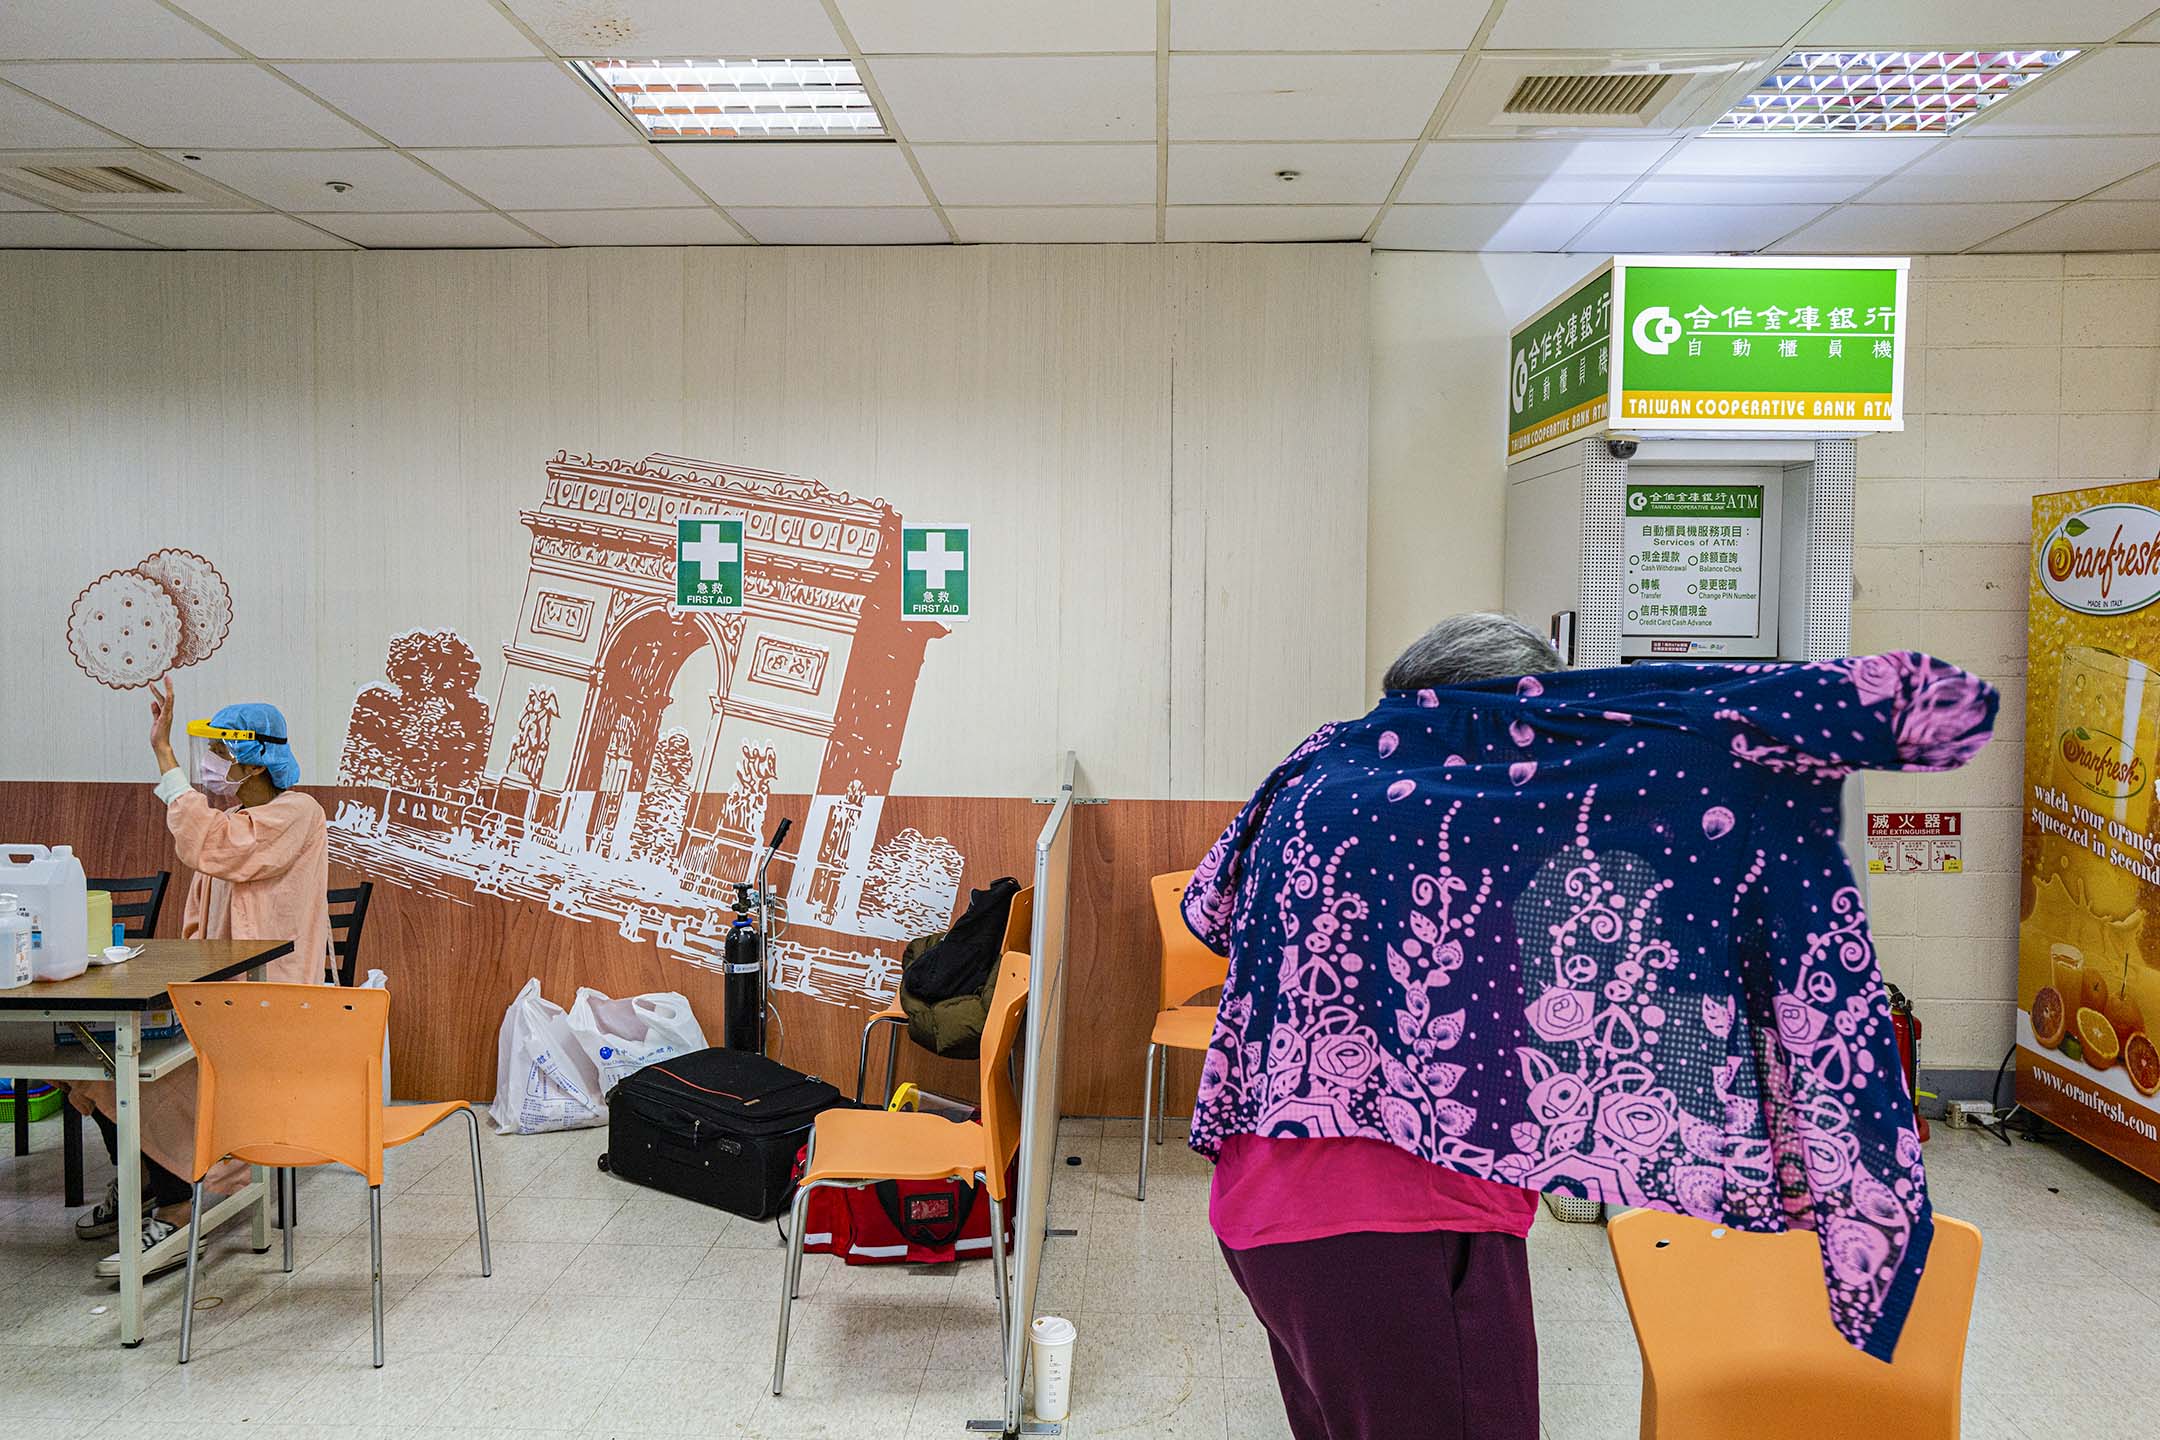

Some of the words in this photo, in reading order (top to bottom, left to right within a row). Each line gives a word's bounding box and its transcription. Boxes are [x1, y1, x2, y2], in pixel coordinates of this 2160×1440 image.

[1683, 304, 1895, 331] 合作金庫銀行
[1528, 291, 1611, 372] 合作金庫銀行
[1687, 337, 1893, 359] 自動櫃員機
[1629, 399, 1691, 415] TAIWAN
[1695, 399, 1806, 416] COOPERATIVE
[1813, 401, 1856, 417] BANK
[1863, 401, 1893, 417] ATM
[1511, 434, 1532, 452] TAIWAN
[1531, 417, 1570, 445] COOPERATIVE
[1572, 409, 1590, 427] BANK
[1592, 402, 1608, 422] ATM
[1726, 494, 1758, 509] ATM
[1653, 538, 1695, 546] Services
[1699, 538, 1709, 546] of
[1713, 538, 1738, 546] ATM:
[1641, 551, 1680, 563] 現金提款
[1699, 551, 1738, 564] 餘額查詢
[1656, 564, 1688, 572] Withdrawal
[1699, 565, 1723, 573] Balance
[1724, 565, 1742, 573] Check
[696, 582, 723, 595] 急救
[686, 595, 715, 605] FIRST
[716, 596, 733, 605] AID
[922, 591, 950, 604] 急救
[1698, 592, 1721, 601] Change
[1734, 592, 1757, 600] Number
[912, 604, 941, 613] FIRST
[942, 604, 960, 613] AID
[2087, 600, 2101, 608] MADE
[2102, 600, 2109, 608] IN
[2034, 785, 2069, 813] watch
[2071, 804, 2105, 832] your
[1872, 813, 1941, 829] 滅火器
[2031, 807, 2089, 848] squeezed
[2092, 833, 2106, 858] in
[2032, 1065, 2158, 1142] www.oranfresh.com
